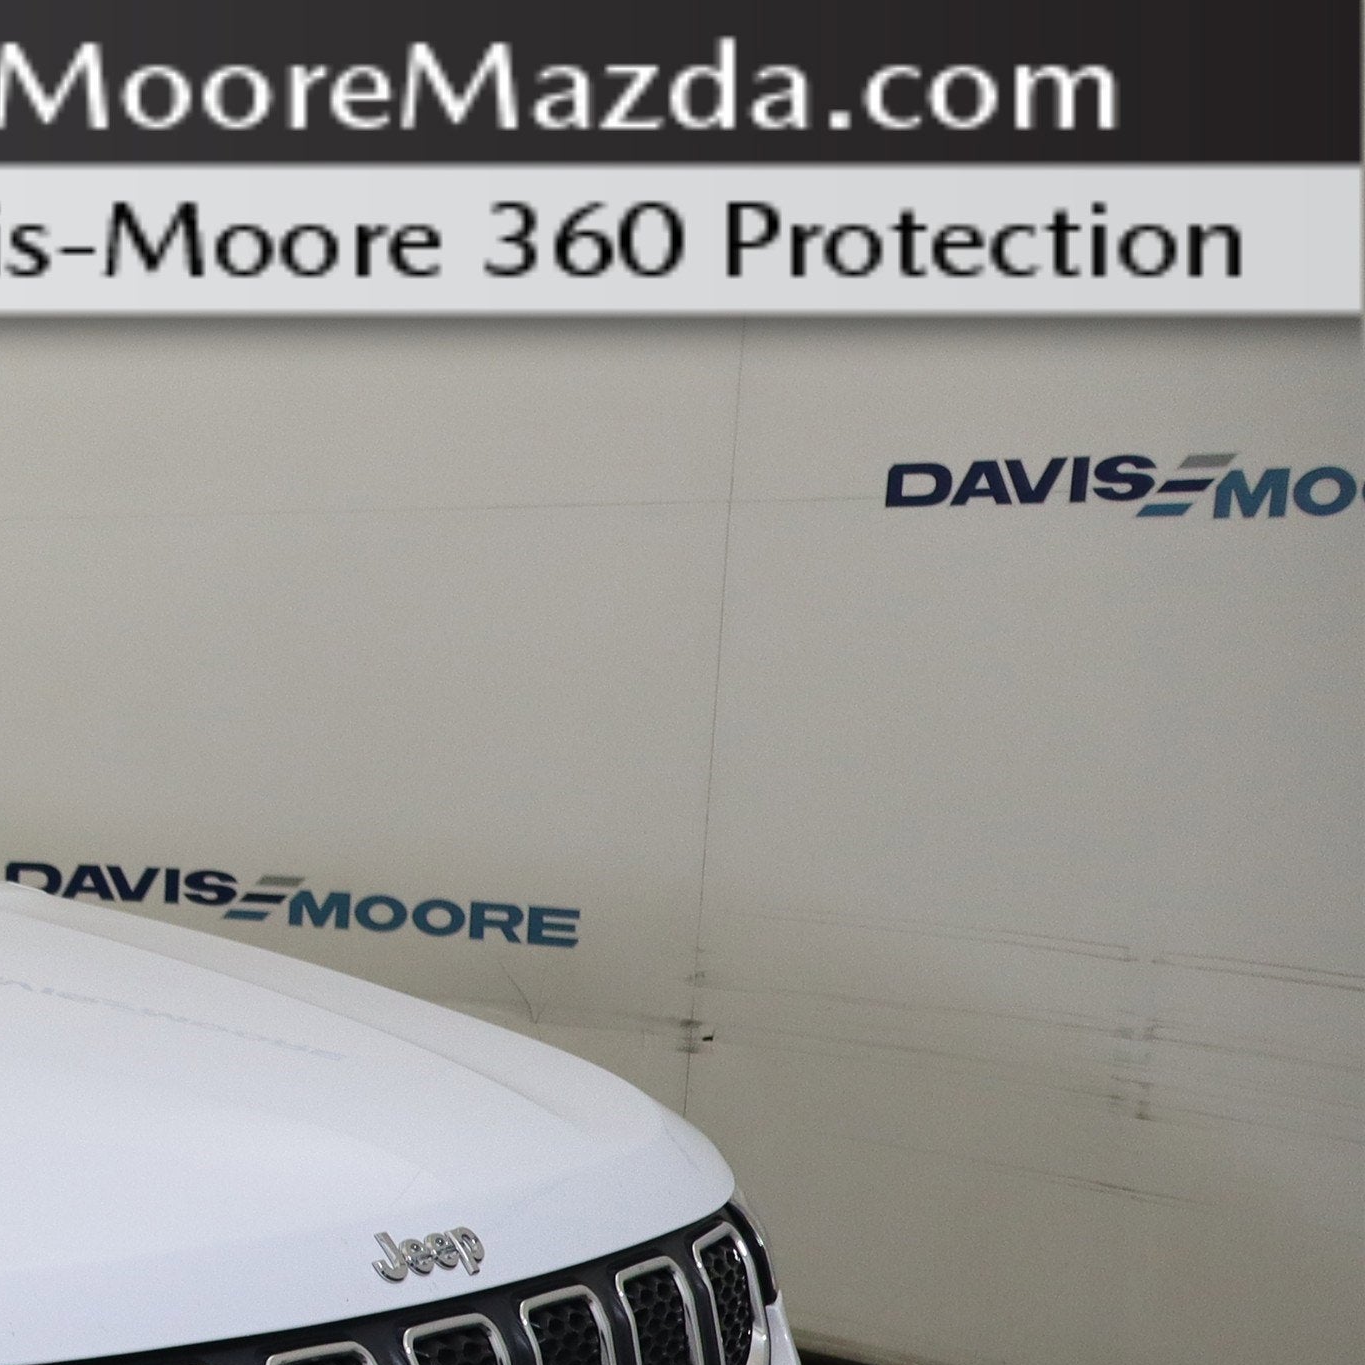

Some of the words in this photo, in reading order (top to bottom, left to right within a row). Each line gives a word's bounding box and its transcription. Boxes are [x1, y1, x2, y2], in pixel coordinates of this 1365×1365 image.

[885, 454, 1157, 508] DAVIS
[5, 861, 238, 905] DAVIS
[288, 890, 581, 949] MOORE
[372, 1226, 486, 1283] Jeep
